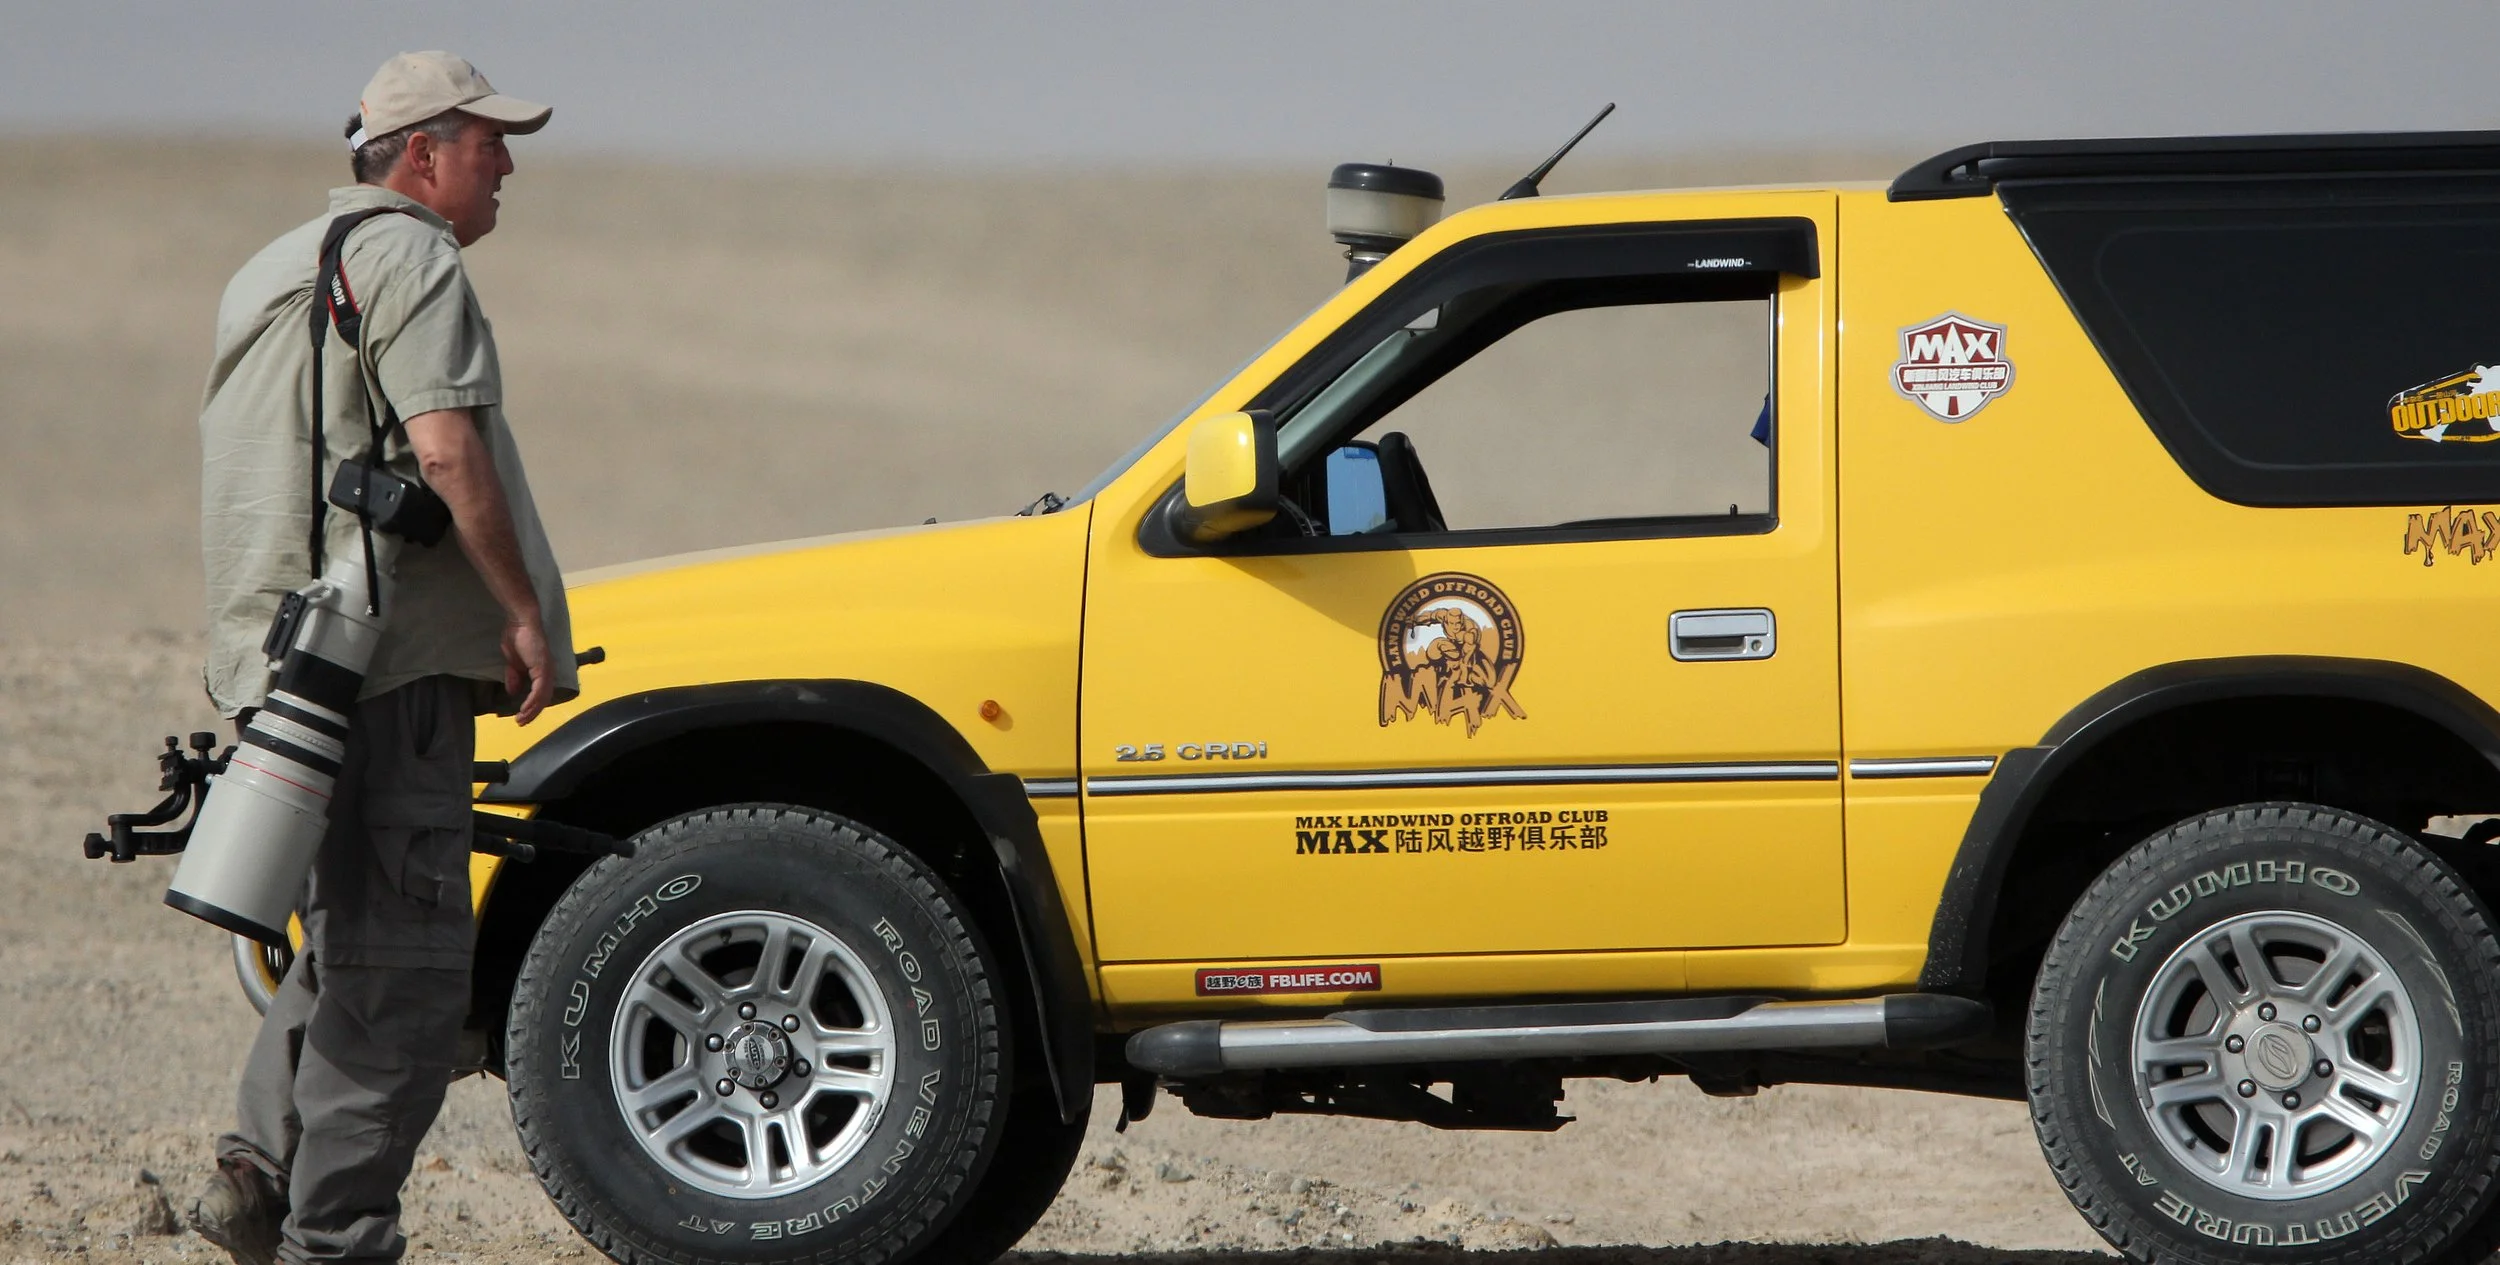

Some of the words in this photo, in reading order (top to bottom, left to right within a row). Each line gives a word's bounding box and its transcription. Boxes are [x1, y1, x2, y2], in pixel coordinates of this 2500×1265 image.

[1911, 324, 1995, 363] MAX
[1388, 587, 1430, 667] LANDWIND
[1434, 581, 1504, 617] OFFROAD
[1500, 618, 1515, 660] CLUB
[1379, 661, 1528, 739] MAX
[1296, 816, 1342, 829] MAX
[1348, 813, 1455, 828] LANDWIND
[1460, 811, 1552, 826] OFFROAD
[1558, 810, 1608, 824] CLUB
[1395, 824, 1608, 853] 陆风越野俱乐部
[1296, 829, 1389, 855] MAX
[2111, 860, 2361, 963] KUMHO
[561, 874, 702, 1080] KUMHO
[873, 916, 941, 1051] ROAD
[1206, 975, 1264, 990] 越野e族
[1269, 971, 1373, 988] FBLIFE.COM
[749, 1040, 761, 1069] AUTO
[2419, 1061, 2463, 1161] ROAD
[749, 1069, 941, 1241] VENTURE
[2119, 1151, 2160, 1188] AT
[679, 1213, 736, 1234] AT
[2153, 1170, 2432, 1247] VENTURE
